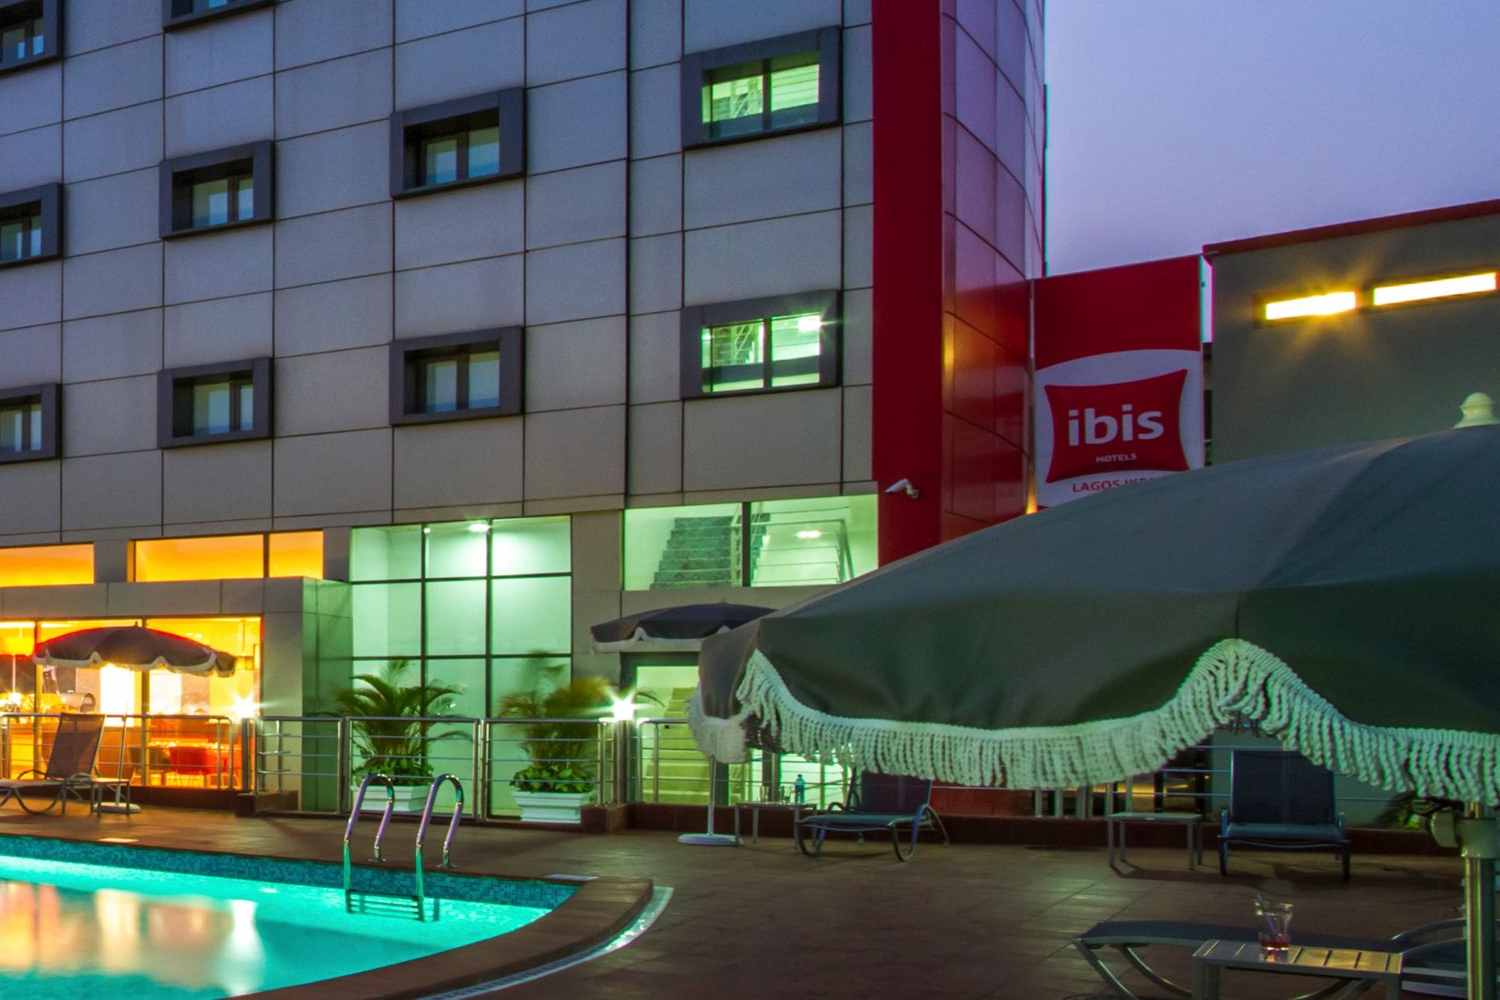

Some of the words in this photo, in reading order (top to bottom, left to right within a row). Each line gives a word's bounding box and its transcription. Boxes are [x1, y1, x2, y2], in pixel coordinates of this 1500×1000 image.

[1067, 403, 1164, 446] ibis
[1095, 452, 1138, 463] HOTELS
[1072, 479, 1120, 493] LAGOS
